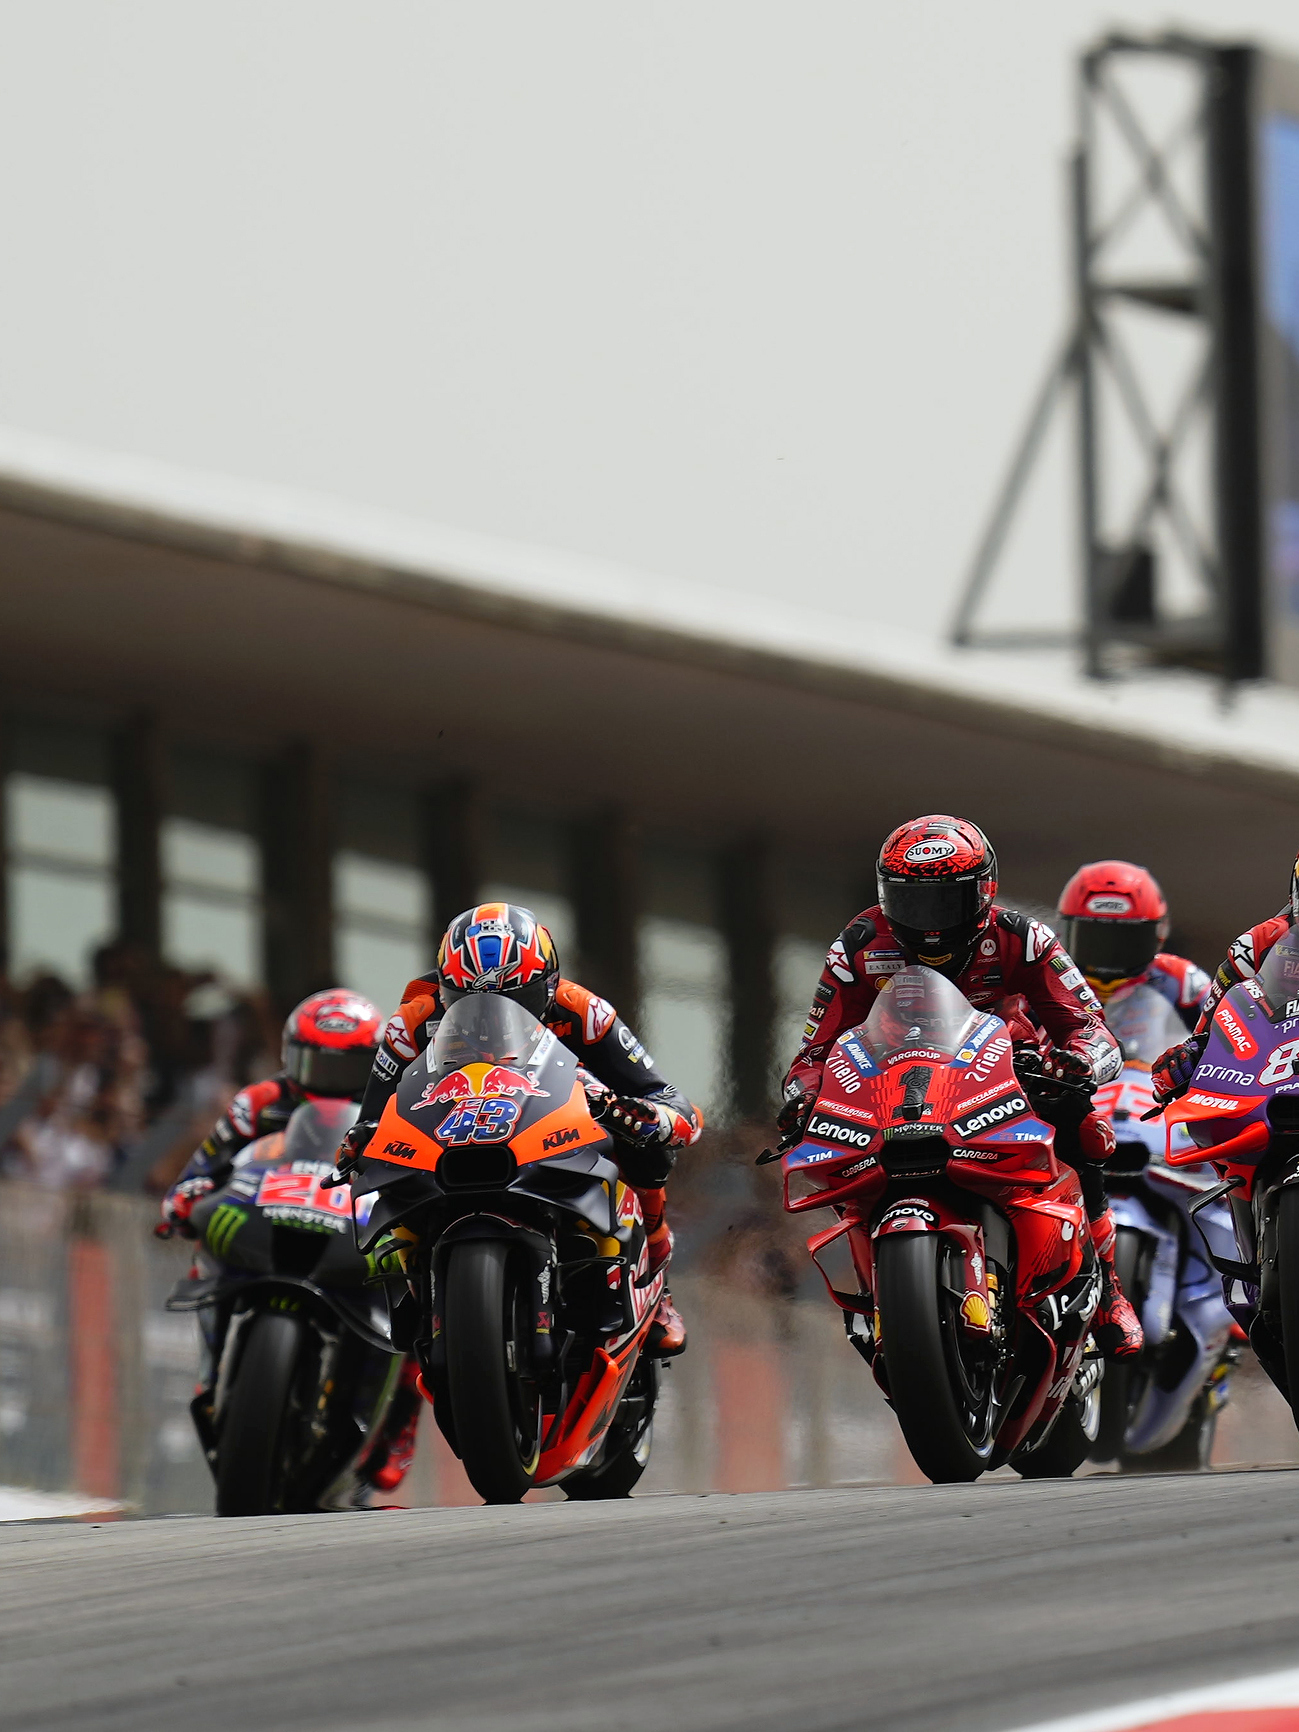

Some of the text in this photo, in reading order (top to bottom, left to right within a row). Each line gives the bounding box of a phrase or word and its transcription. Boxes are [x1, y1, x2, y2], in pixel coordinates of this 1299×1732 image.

[909, 846, 950, 856] SUOMY
[868, 962, 902, 970] EATALY
[1217, 1009, 1252, 1052] PRAMAC
[976, 1037, 1012, 1074] riello
[828, 1060, 862, 1094] riello
[1195, 1063, 1256, 1087] prima
[890, 1065, 938, 1120] 1
[957, 1080, 1016, 1110] FRECCIAROSSA
[1186, 1093, 1240, 1111] MOTUL
[817, 1099, 874, 1120] FRECCIAROSSA
[953, 1098, 1026, 1137] Lenovo
[434, 1097, 522, 1147] 43
[807, 1116, 871, 1146] Lenovo
[893, 1123, 944, 1134] MONSTER
[542, 1127, 581, 1151] KTM
[1014, 1132, 1042, 1141] TIM
[382, 1140, 418, 1160] KTM
[806, 1150, 833, 1163] TIM
[952, 1148, 998, 1160] CARRERA
[841, 1156, 877, 1178] CARRERA
